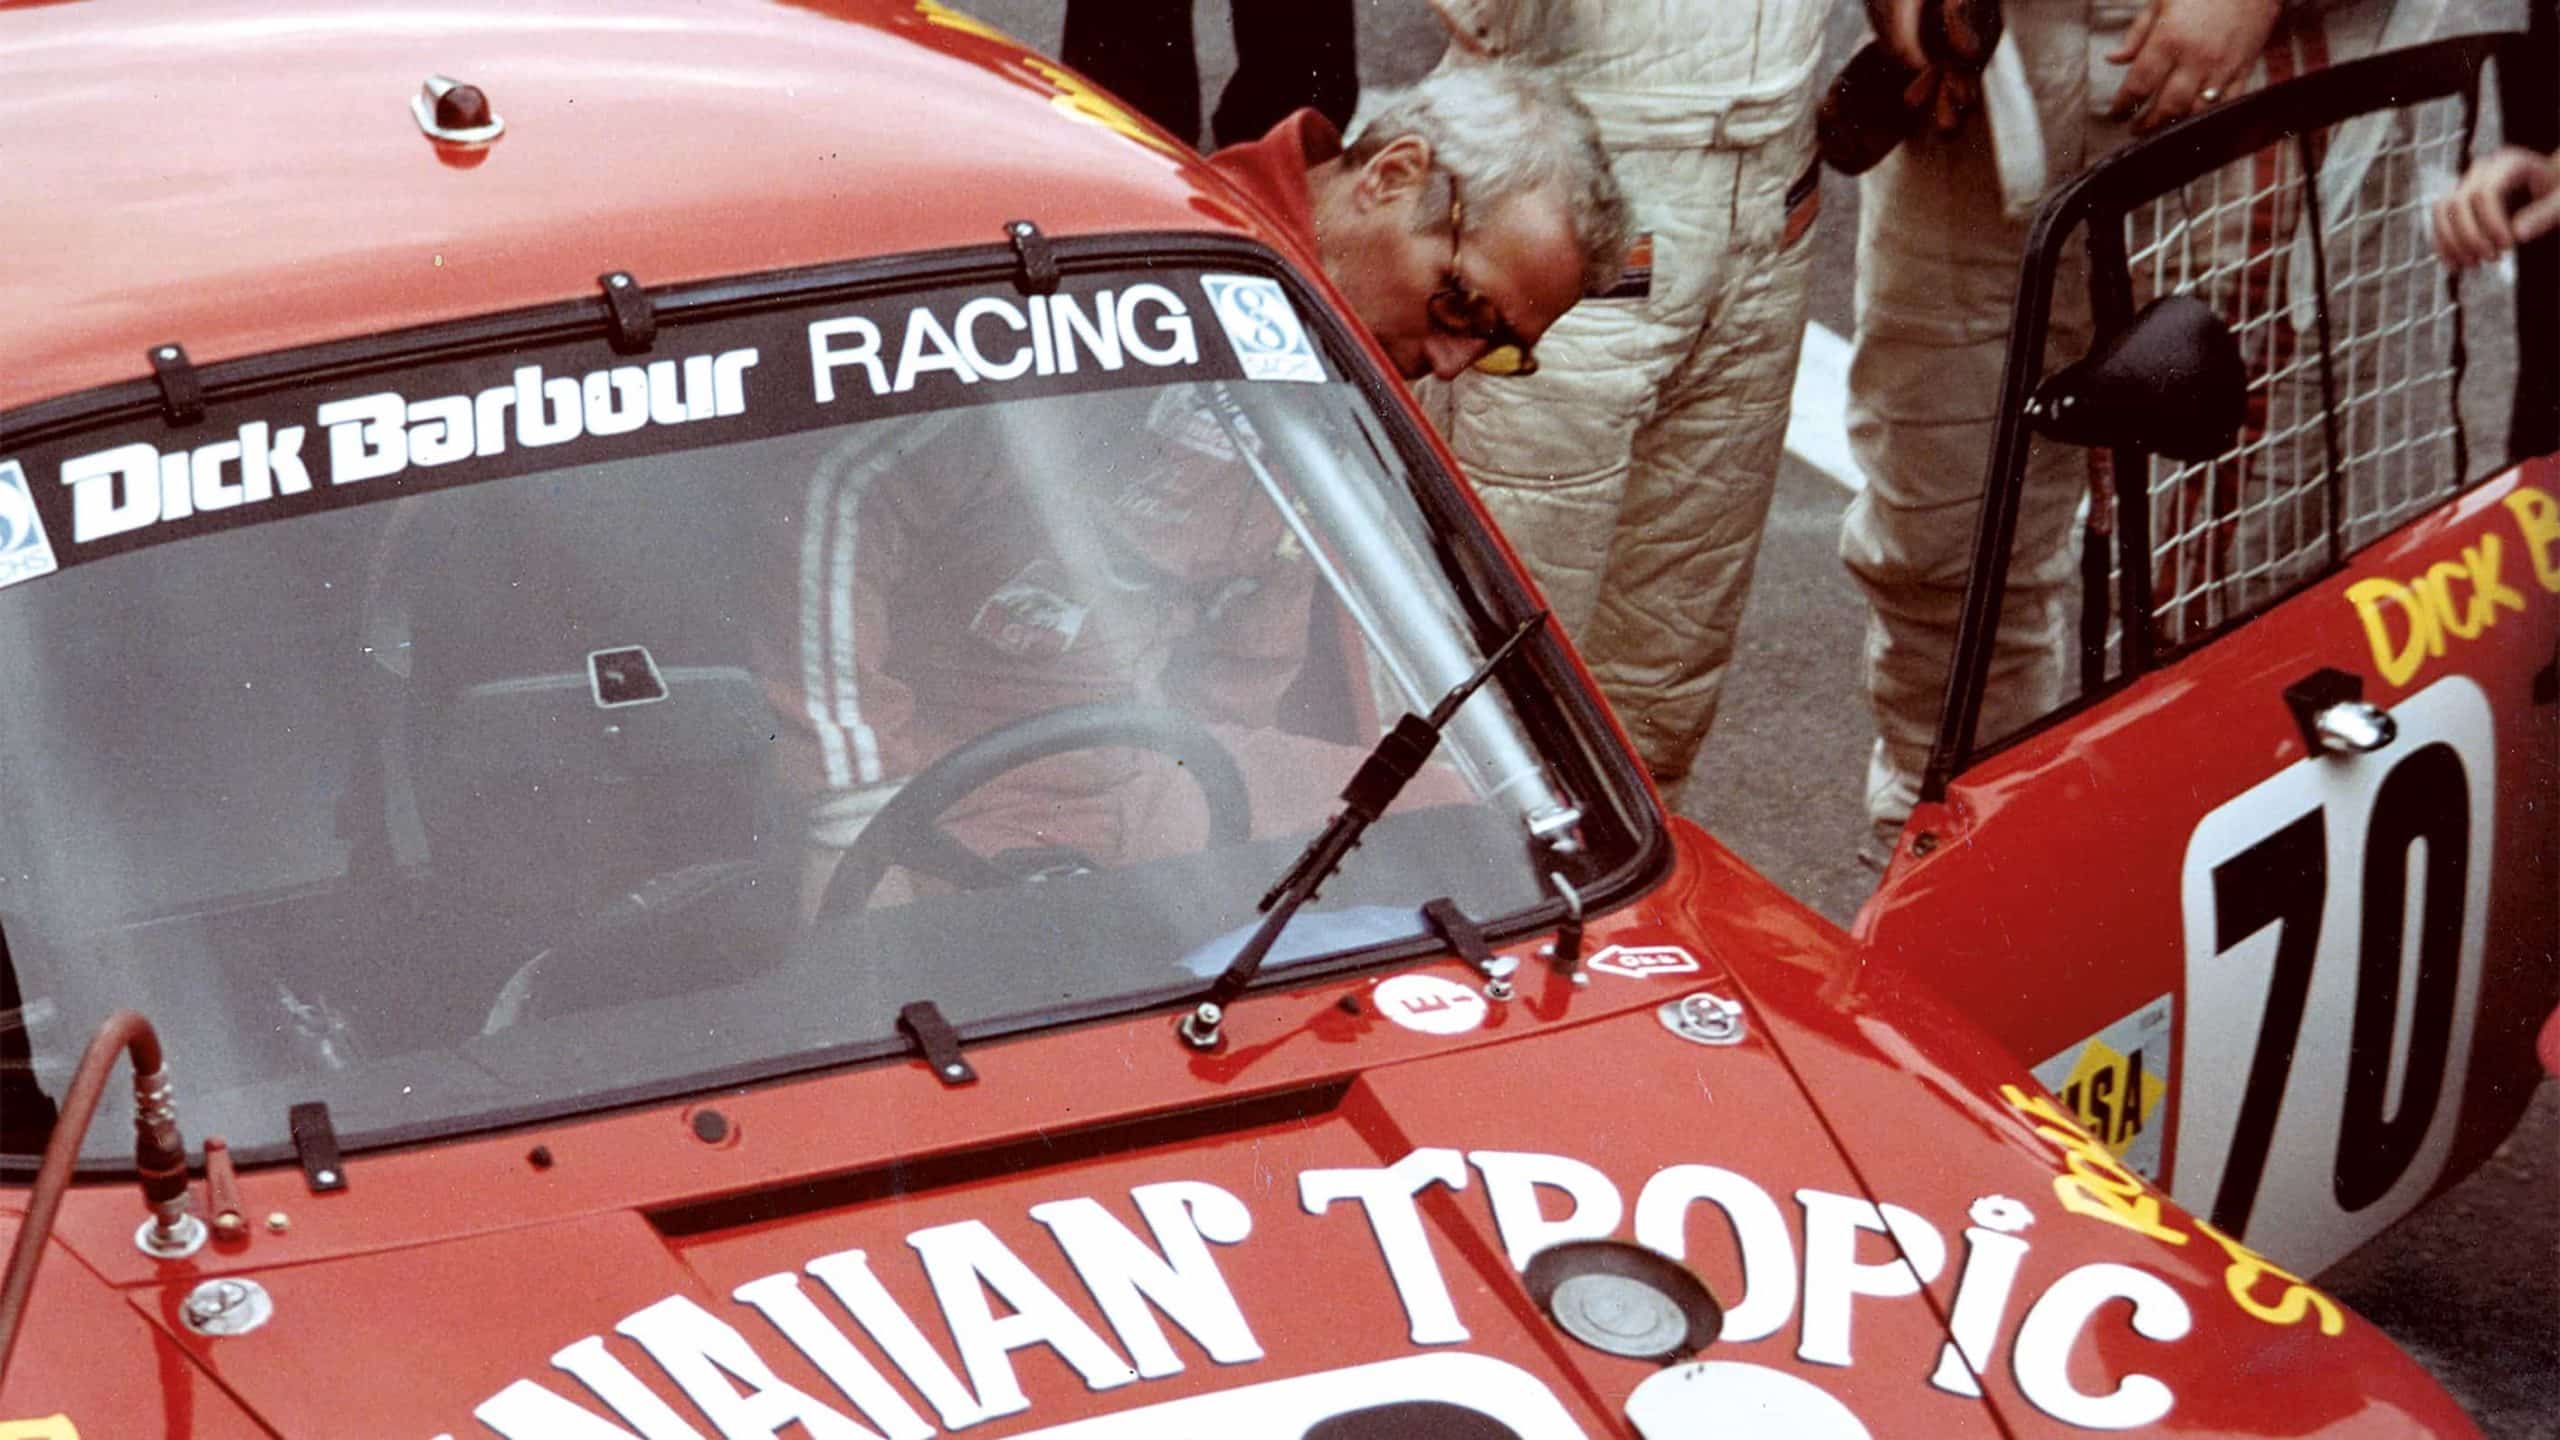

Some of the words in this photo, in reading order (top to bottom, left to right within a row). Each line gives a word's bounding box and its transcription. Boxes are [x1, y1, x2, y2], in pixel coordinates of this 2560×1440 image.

[60, 421, 313, 544] Dick
[317, 348, 760, 485] Barbour
[808, 283, 1198, 403] RACING
[2344, 533, 2526, 687] DICK
[2211, 741, 2472, 1243] 70
